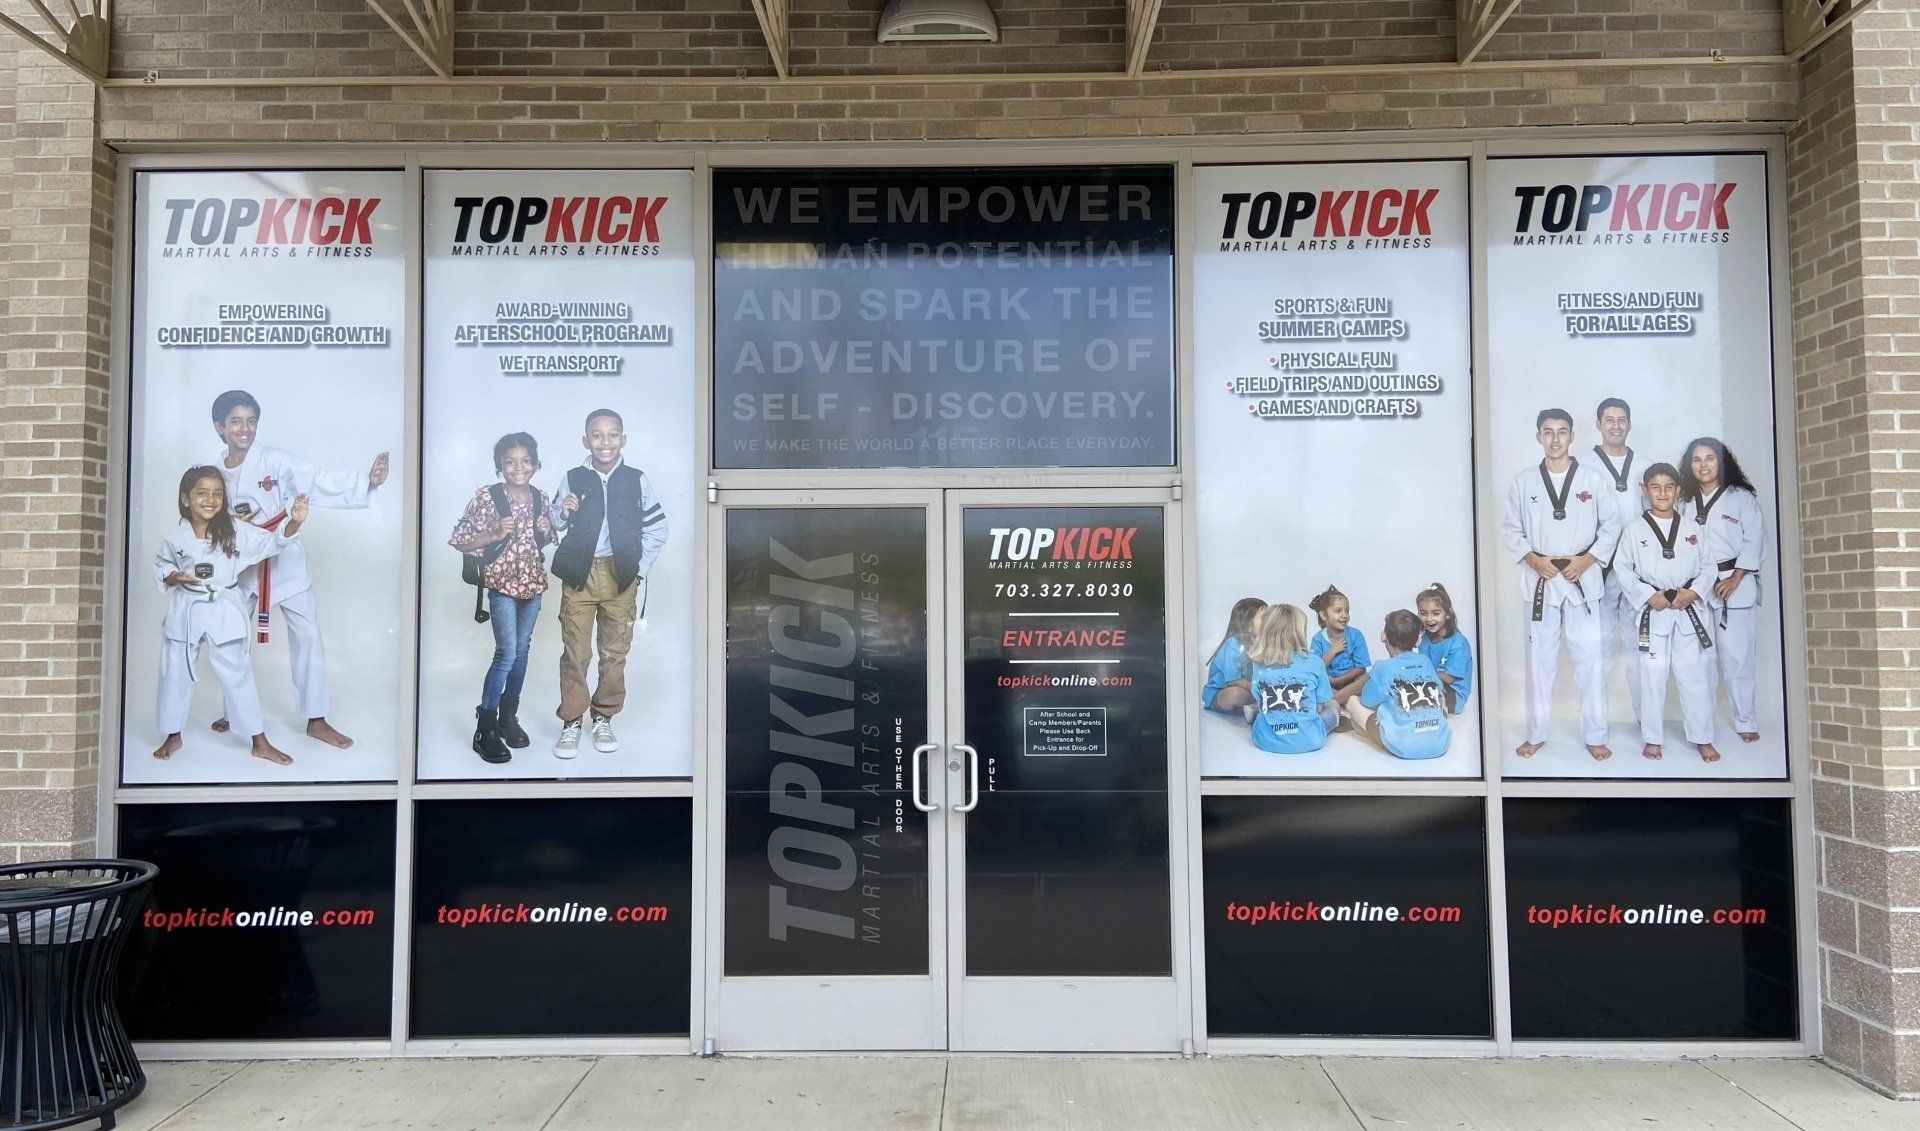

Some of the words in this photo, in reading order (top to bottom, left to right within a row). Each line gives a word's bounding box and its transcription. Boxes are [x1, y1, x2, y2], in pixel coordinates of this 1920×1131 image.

[733, 187, 820, 224] WE
[848, 184, 1152, 224] EMPOWER
[1515, 183, 1737, 233] TOPKICK
[165, 198, 382, 245] TOPKICK
[454, 196, 668, 243] TOPKICK
[1221, 189, 1440, 239] TOPKICK
[1220, 241, 1288, 252] MARTIAL
[1298, 240, 1337, 250] ARTS
[1347, 239, 1355, 249] &
[1366, 238, 1431, 249] FITNESS
[1514, 235, 1583, 246] MARTIAL
[1593, 234, 1634, 244] ARTS
[1644, 234, 1652, 243] &
[1663, 232, 1730, 243] FITNESS
[163, 247, 230, 258] MARTIAL
[240, 247, 279, 257] ARTS
[289, 247, 296, 257] &
[307, 247, 373, 257] FITNESS
[452, 246, 519, 256] MARTIAL
[529, 246, 568, 255] ARTS
[578, 246, 585, 255] &
[596, 246, 660, 255] FITNESS
[731, 242, 888, 270] HUMAN
[908, 240, 1153, 269] POTENTIAL
[733, 289, 841, 321] AND
[859, 288, 1031, 321] SPARK
[1052, 286, 1153, 320] THE
[1274, 298, 1335, 314] SPORTS
[1340, 298, 1351, 312] &
[1356, 298, 1386, 312] FUN
[1558, 293, 1623, 308] FITNESS
[1627, 292, 1661, 307] AND
[1666, 292, 1696, 306] FUN
[219, 304, 324, 319] EMPOWERING
[495, 303, 626, 318] AWARD-WINNING
[1258, 322, 1335, 337] SUMMER
[1342, 320, 1404, 336] CAMPS
[1566, 316, 1603, 332] FOR
[1606, 316, 1638, 331] ALL
[1643, 315, 1689, 331] AGES
[157, 327, 265, 343] CONFIDENCE
[268, 327, 306, 342] AND
[311, 327, 384, 342] GROWTH
[455, 325, 577, 341] AFTERSCHOOL
[582, 325, 667, 340] PROGRAM
[499, 356, 524, 370] WE
[526, 356, 618, 370] TRANSPORT
[733, 339, 1060, 374] ADVENTURE
[1085, 338, 1153, 372] OF
[1280, 353, 1356, 368] PHYSICAL
[1361, 352, 1391, 366] FUN
[1236, 377, 1278, 392] FIELD
[1283, 376, 1328, 391] TRIPS
[1329, 376, 1364, 390] AND
[1370, 375, 1438, 390] OUTINGS
[732, 393, 839, 420] SELF
[893, 392, 1153, 419] DISCOVERY.
[1258, 400, 1313, 415] GAMES
[1316, 400, 1350, 414] AND
[1355, 399, 1416, 414] CRAFTS
[734, 439, 758, 451] WE
[765, 439, 810, 450] MAKE
[816, 439, 848, 450] THE
[854, 438, 914, 450] WORLD
[920, 438, 930, 450] A
[937, 438, 999, 450] BETTER
[1007, 438, 1058, 449] PLACE
[1066, 437, 1154, 449] EVERYDAY.
[989, 527, 1138, 560] TOPKICK
[988, 561, 1035, 569] MARTIAL
[1042, 561, 1069, 569] ARTS
[1075, 561, 1081, 569] &
[1087, 561, 1133, 569] FITNESS
[994, 583, 1134, 597] 703.327.8030
[861, 552, 879, 671] FITNESS
[1002, 630, 1126, 647] ENTRANCE
[997, 675, 1133, 688] topkickonline.com
[862, 692, 880, 704] &
[768, 536, 857, 941] TOPKICK
[862, 724, 880, 796] ARTS
[895, 800, 903, 833] DOOR
[862, 816, 880, 944] MARTIAL
[144, 907, 374, 931] topkickonline.com
[438, 903, 668, 927] topkickonline.com
[1227, 902, 1461, 925] topkickonline.com
[1528, 904, 1766, 928] topkickonline.com
